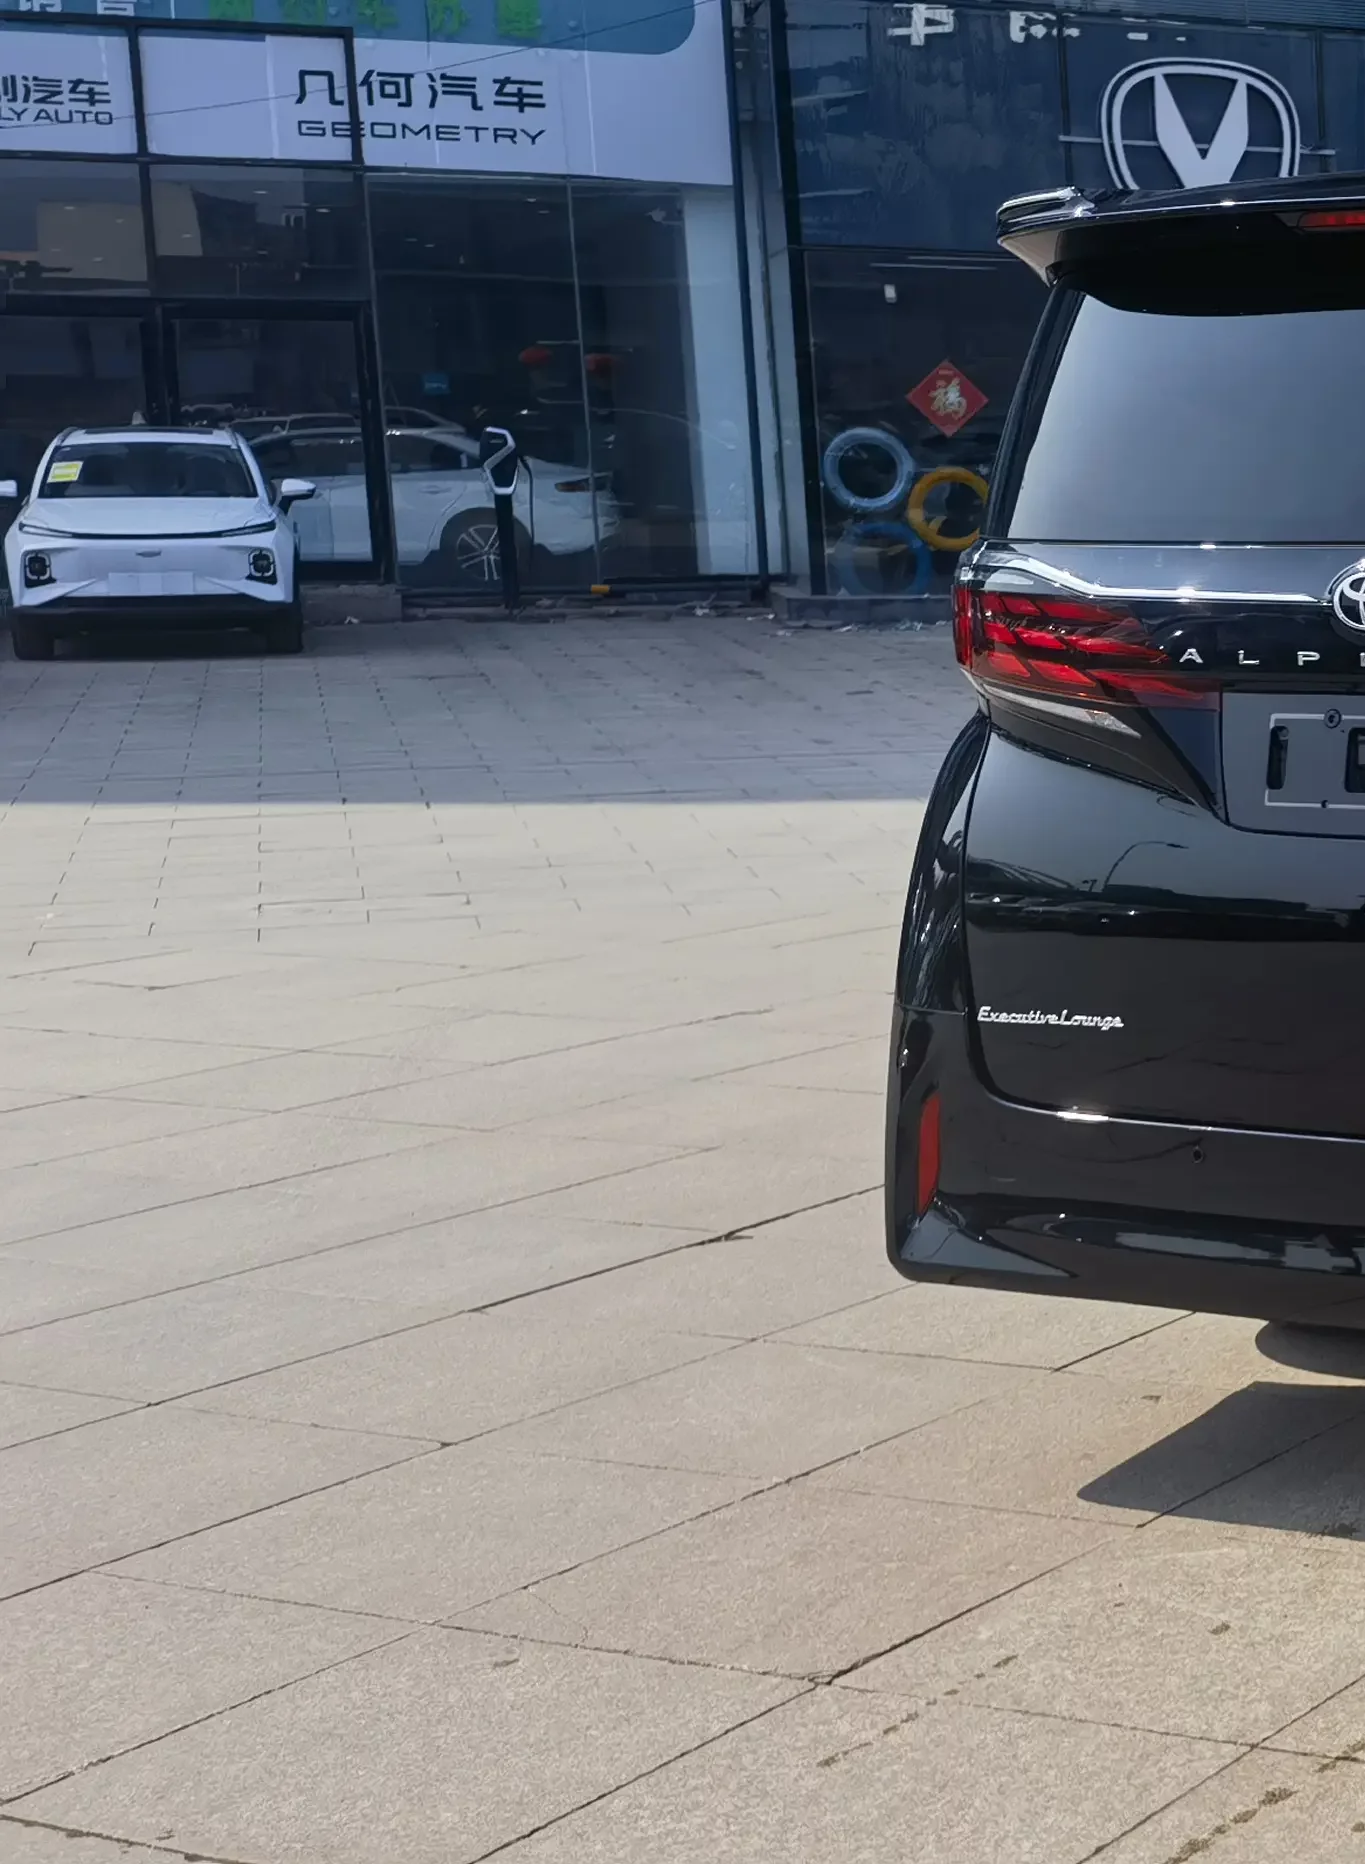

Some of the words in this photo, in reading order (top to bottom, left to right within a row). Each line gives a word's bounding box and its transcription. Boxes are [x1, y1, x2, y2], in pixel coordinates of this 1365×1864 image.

[295, 69, 547, 113] 几何汽车
[34, 108, 113, 125] AUTO
[297, 120, 547, 146] GEOMETRY
[928, 377, 967, 420] 福
